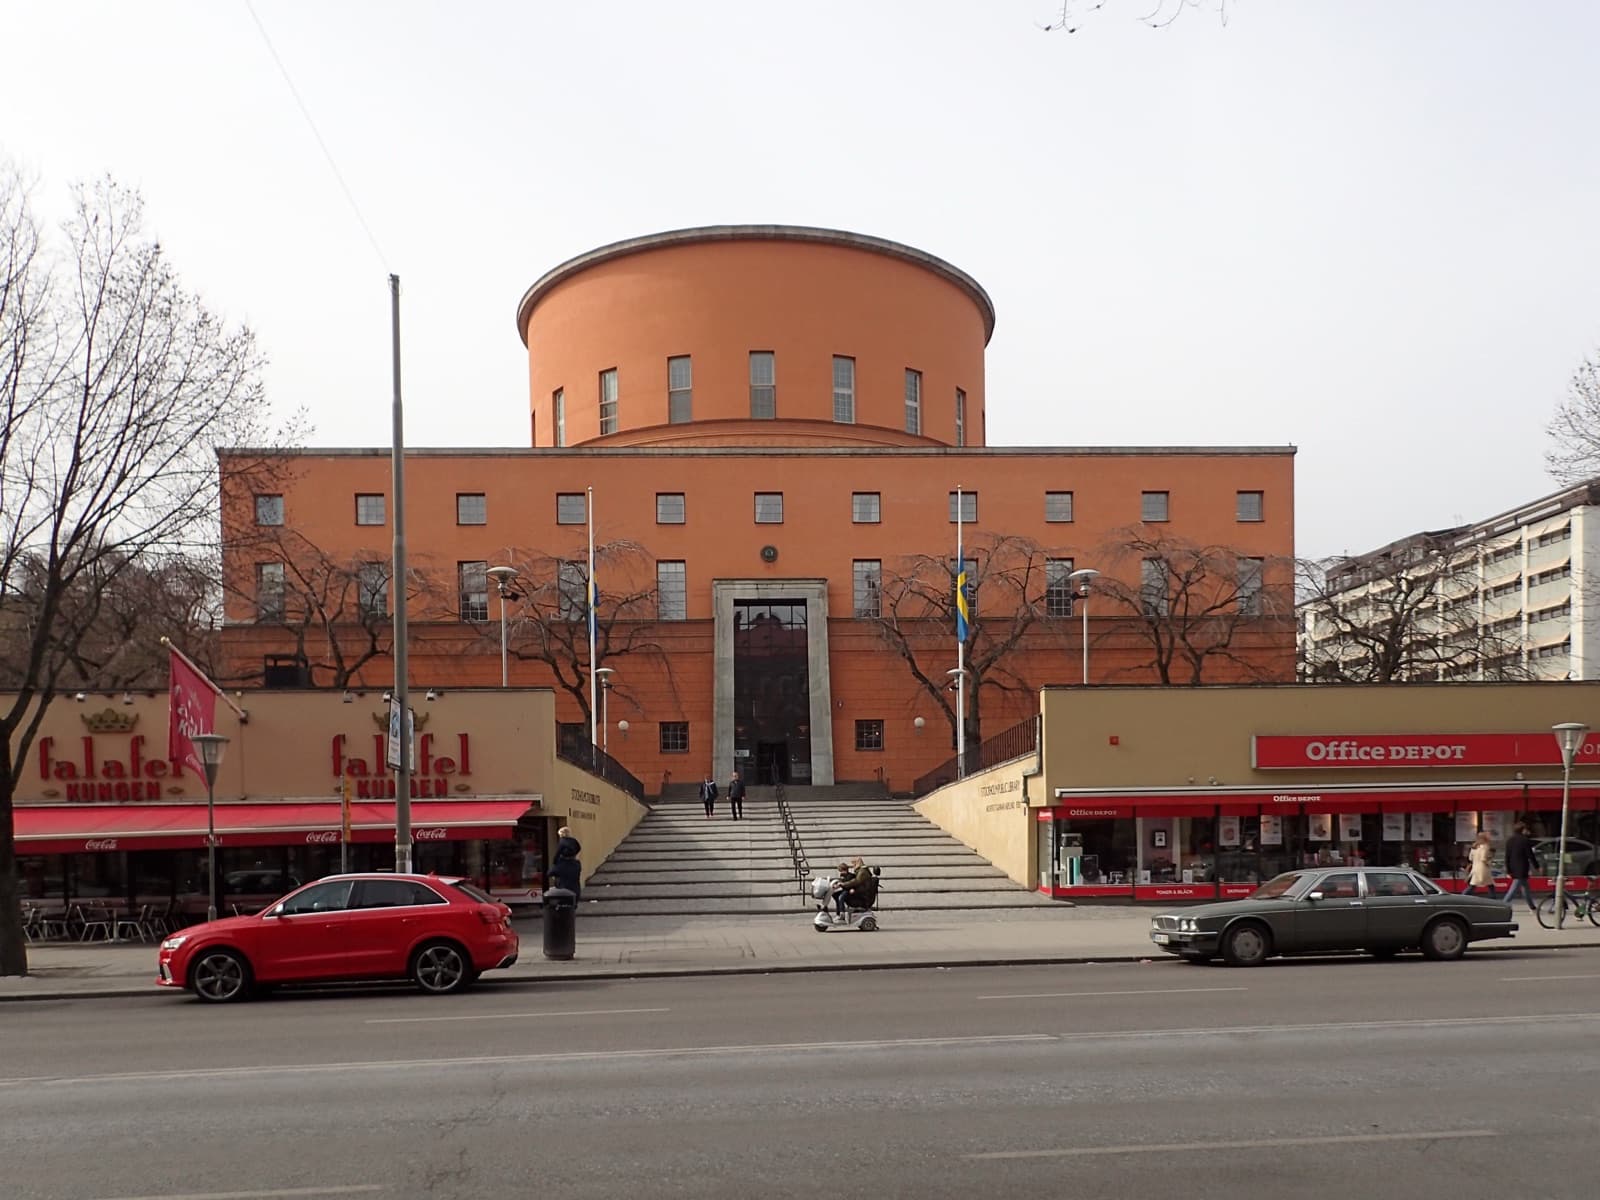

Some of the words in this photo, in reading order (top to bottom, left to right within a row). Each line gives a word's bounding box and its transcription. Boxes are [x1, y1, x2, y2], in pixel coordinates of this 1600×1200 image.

[332, 733, 472, 778] falfel
[1306, 741, 1385, 761] Office
[1389, 745, 1466, 760] DEPOT
[66, 781, 161, 802] KUNGEN
